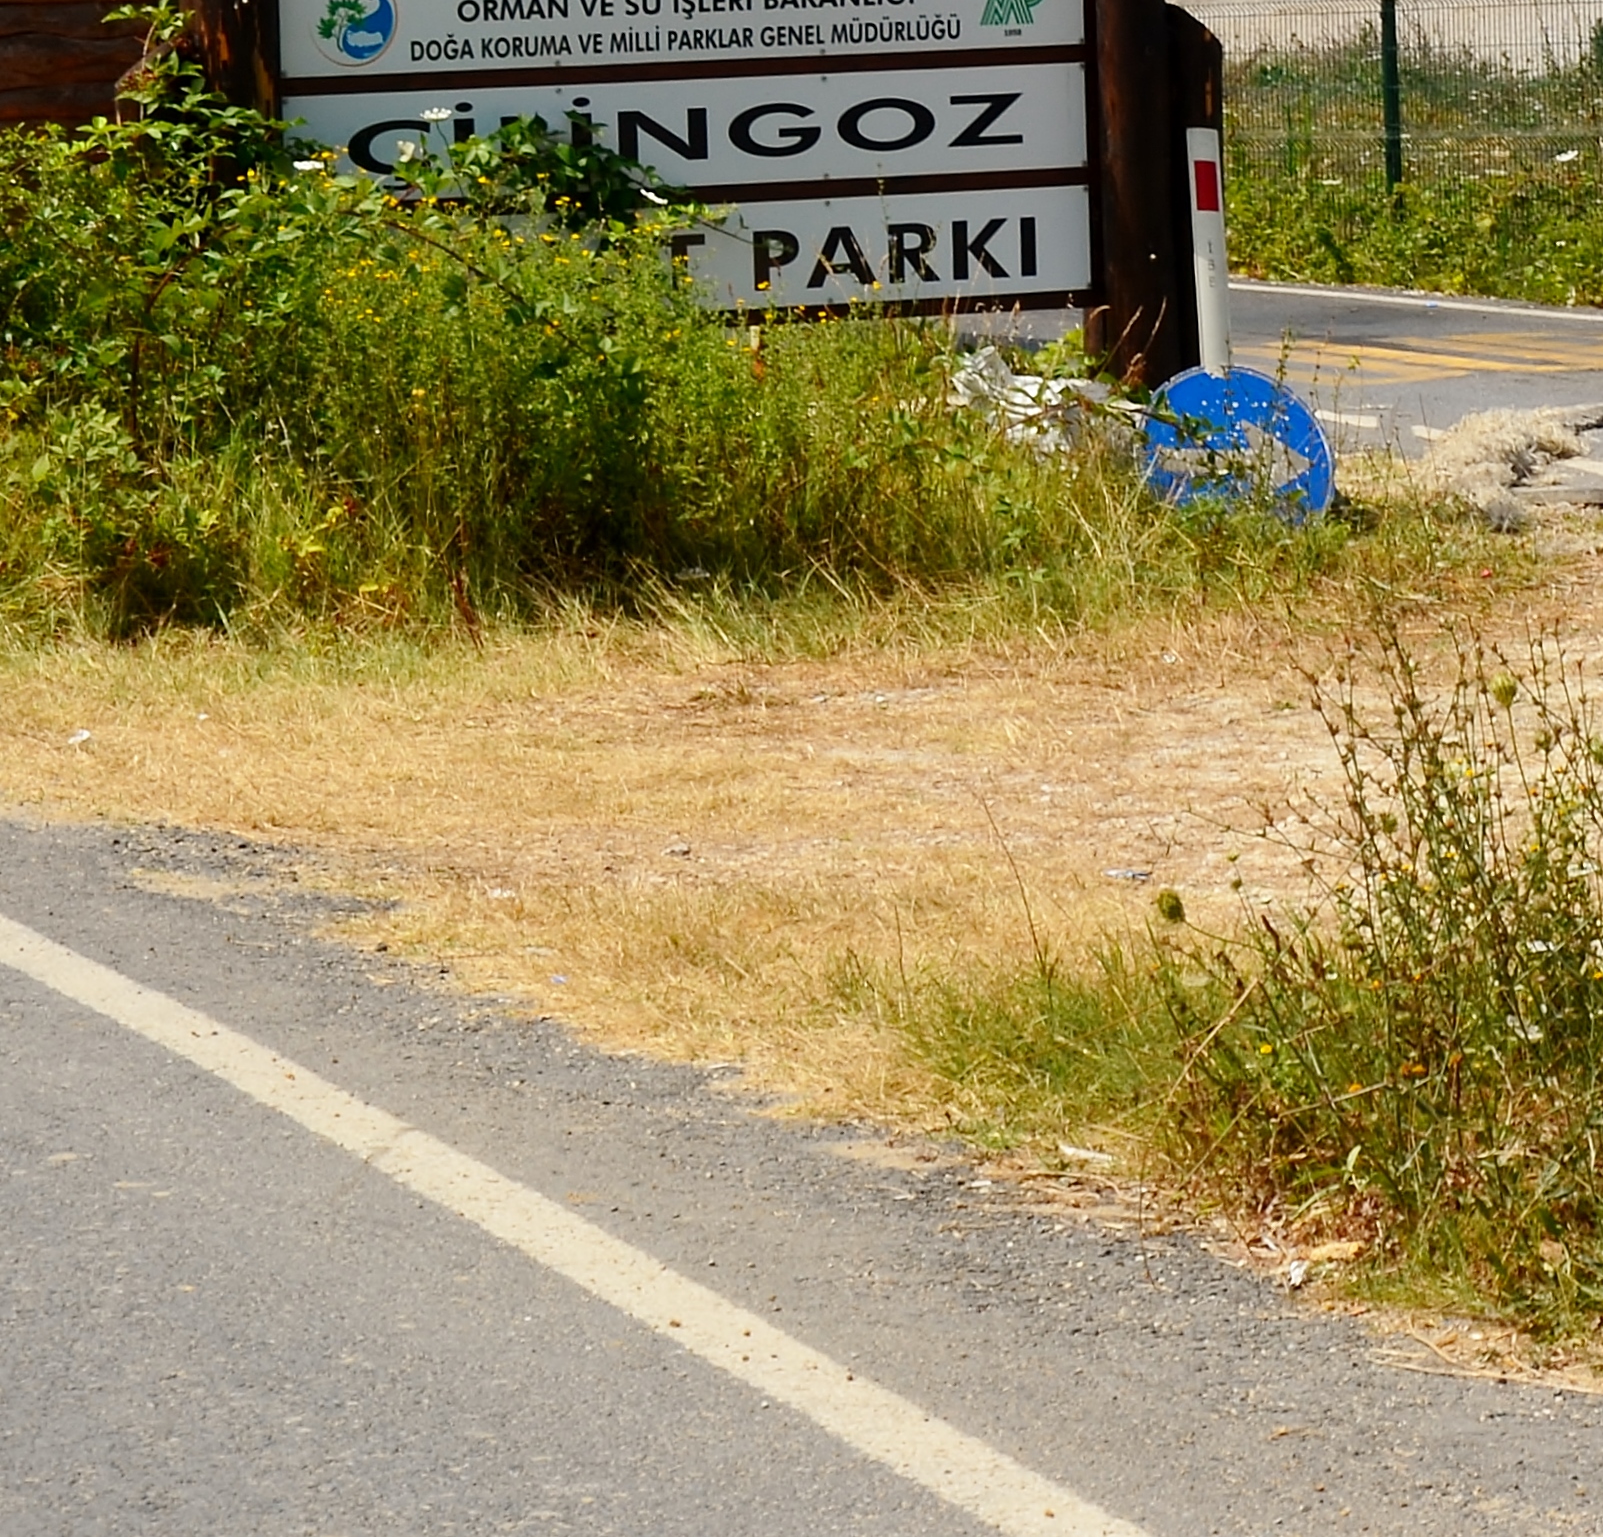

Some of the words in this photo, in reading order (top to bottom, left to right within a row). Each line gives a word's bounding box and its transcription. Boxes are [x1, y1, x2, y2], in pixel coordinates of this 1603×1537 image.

[410, 33, 475, 62] DOĞA
[481, 35, 573, 60] KORUMA
[579, 33, 604, 55] VE
[610, 25, 661, 54] MİLLİ
[667, 27, 754, 51] PARKLAR
[760, 25, 826, 48] GENEL
[831, 13, 962, 44] MÜDÜRLÜĞÜ
[347, 92, 1024, 191] ÇİİNGOZ
[752, 216, 1038, 292] PARKI
